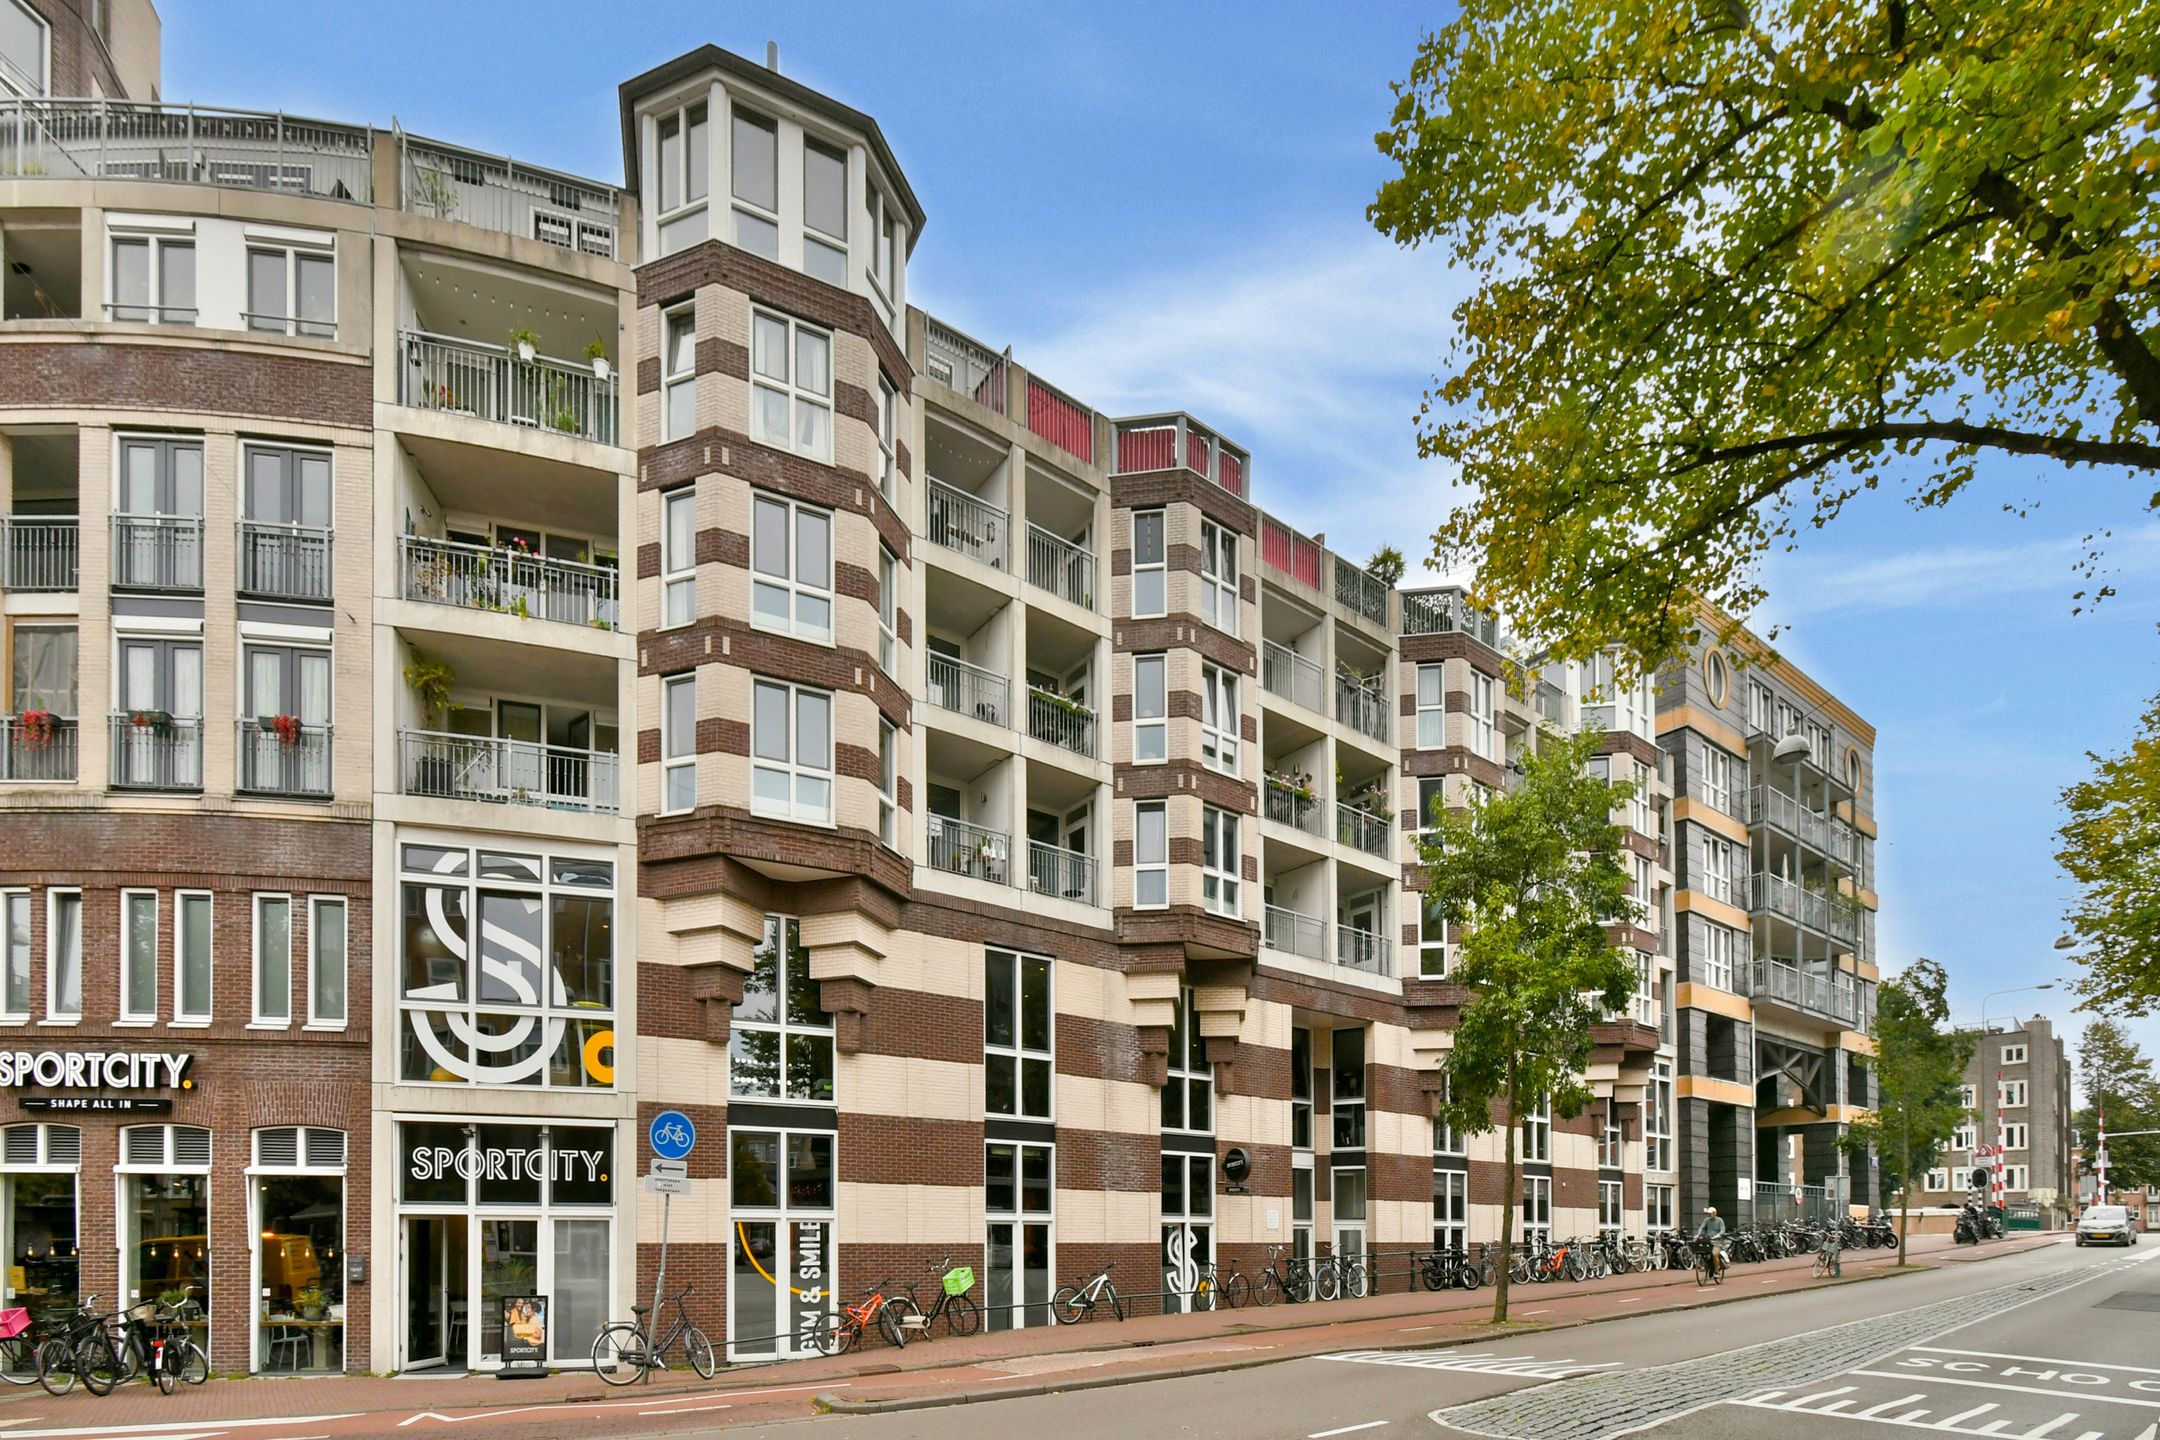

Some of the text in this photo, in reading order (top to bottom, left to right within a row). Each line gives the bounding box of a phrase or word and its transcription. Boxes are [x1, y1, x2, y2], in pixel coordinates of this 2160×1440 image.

[50, 1099, 131, 1109] SHAPE ALL IN
[799, 1222, 822, 1280] SMILE
[799, 1285, 822, 1304] &
